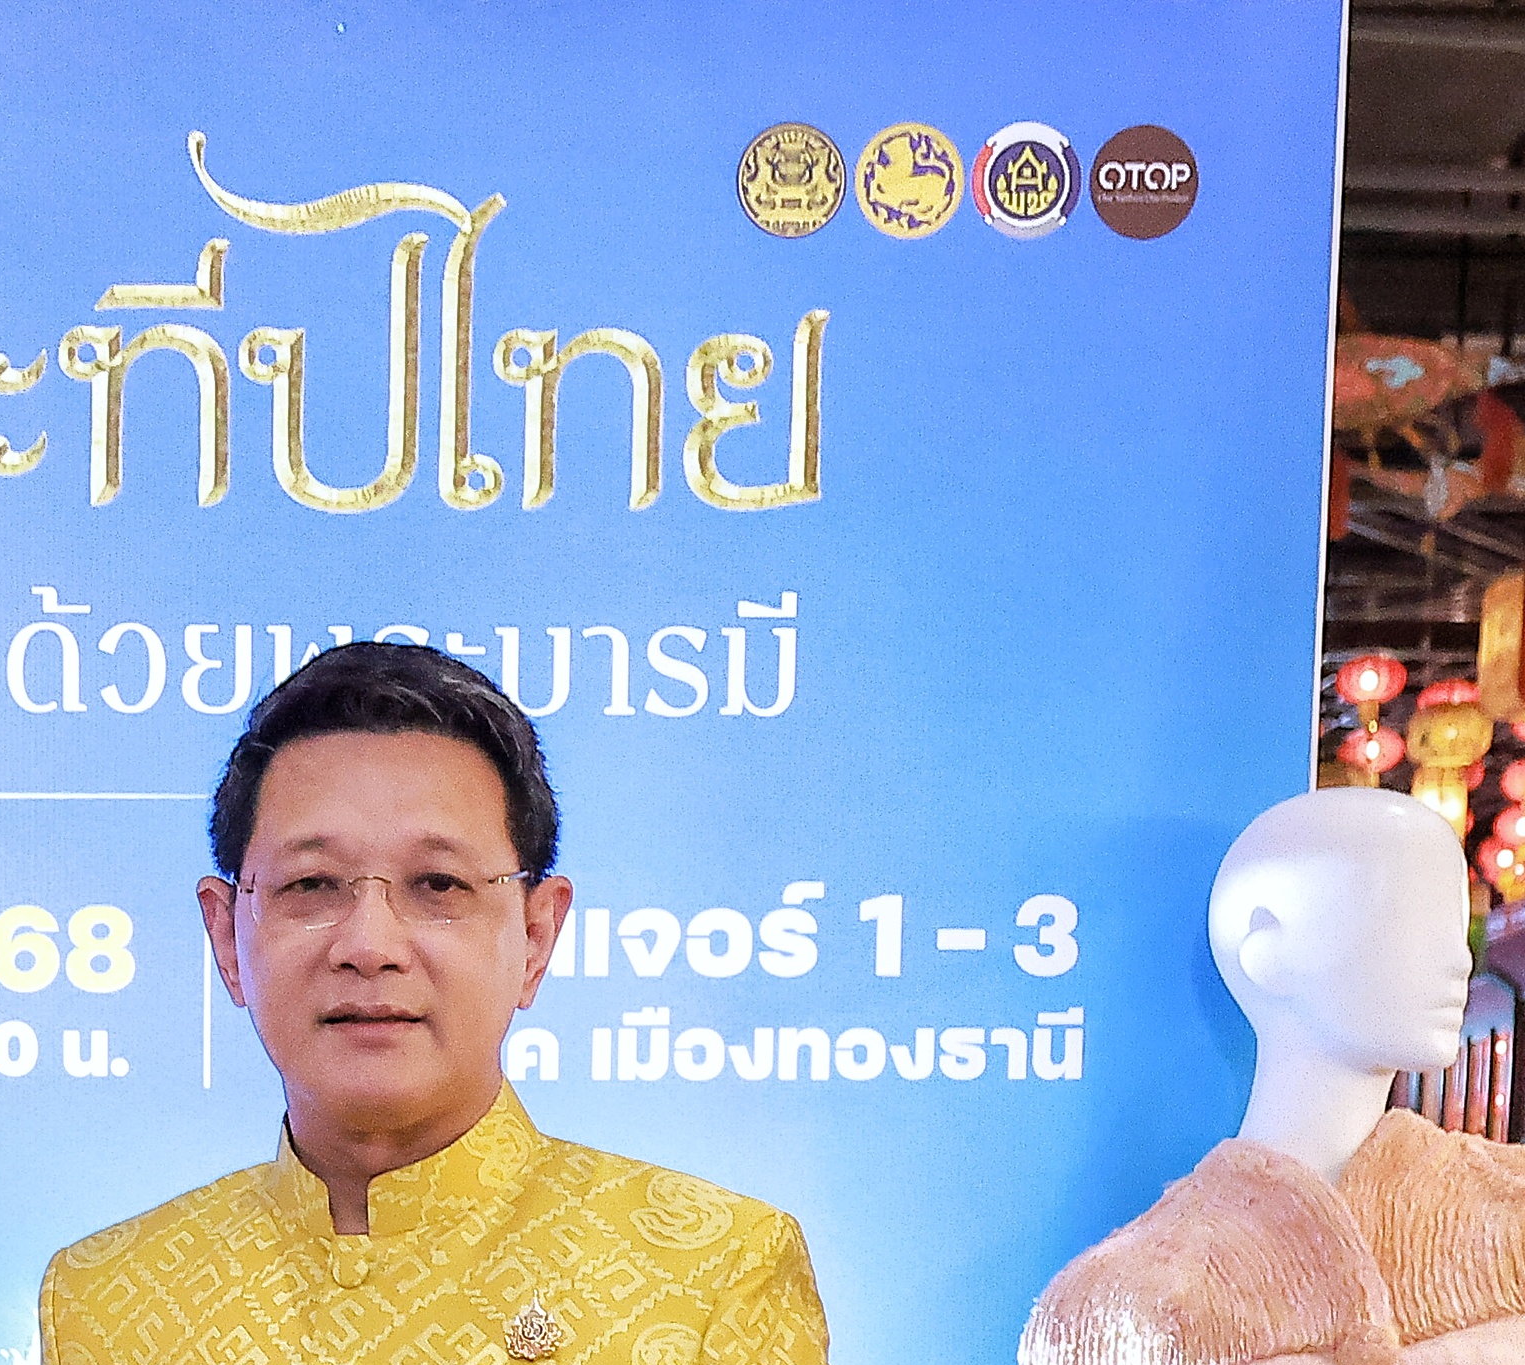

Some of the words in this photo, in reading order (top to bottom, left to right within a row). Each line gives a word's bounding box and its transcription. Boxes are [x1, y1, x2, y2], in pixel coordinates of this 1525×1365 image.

[1099, 161, 1192, 191] OTOP
[6, 584, 798, 718] ด้วยบารมี
[858, 893, 904, 977] 1
[1012, 893, 1081, 978] 3
[62, 1027, 130, 1078] น.
[591, 1005, 1083, 1082] เมืองทองธานี
